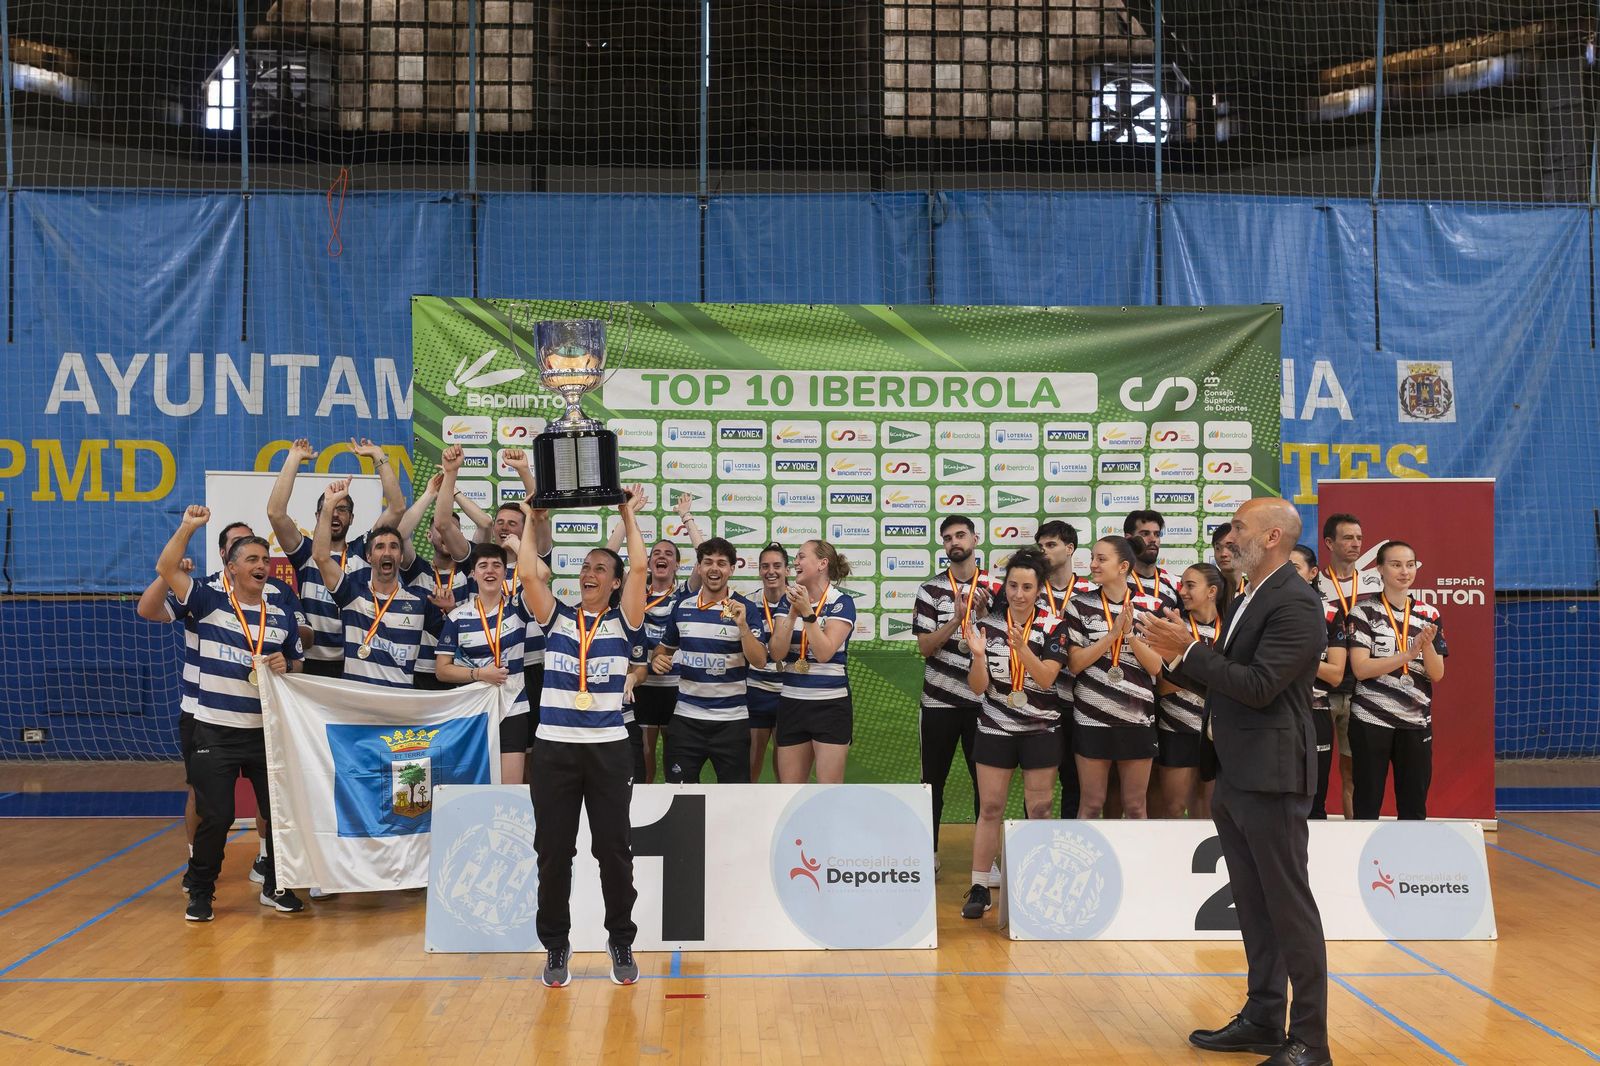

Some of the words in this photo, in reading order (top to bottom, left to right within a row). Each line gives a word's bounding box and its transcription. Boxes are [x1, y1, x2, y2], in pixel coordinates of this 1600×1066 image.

[641, 374, 731, 406] TOP
[746, 375, 794, 406] 10
[809, 376, 1061, 408] IBERDROLA
[1204, 390, 1233, 398] Consejo
[1204, 397, 1236, 405] Superior
[737, 430, 761, 438] YONEX
[1064, 432, 1087, 440] YONEX
[463, 458, 486, 466] YONEX
[792, 462, 815, 470] YONEX
[1117, 463, 1139, 471] YONEX
[847, 494, 869, 503] YONEX
[1170, 494, 1192, 502] YONEX
[572, 524, 596, 533] YONEX
[900, 526, 924, 535] YONEX
[1437, 576, 1485, 586] ESPAÑA
[903, 856, 920, 867] de
[631, 795, 706, 942] 1
[826, 868, 921, 887] Deportes
[1455, 872, 1468, 881] de
[1398, 882, 1469, 897] Deportes
